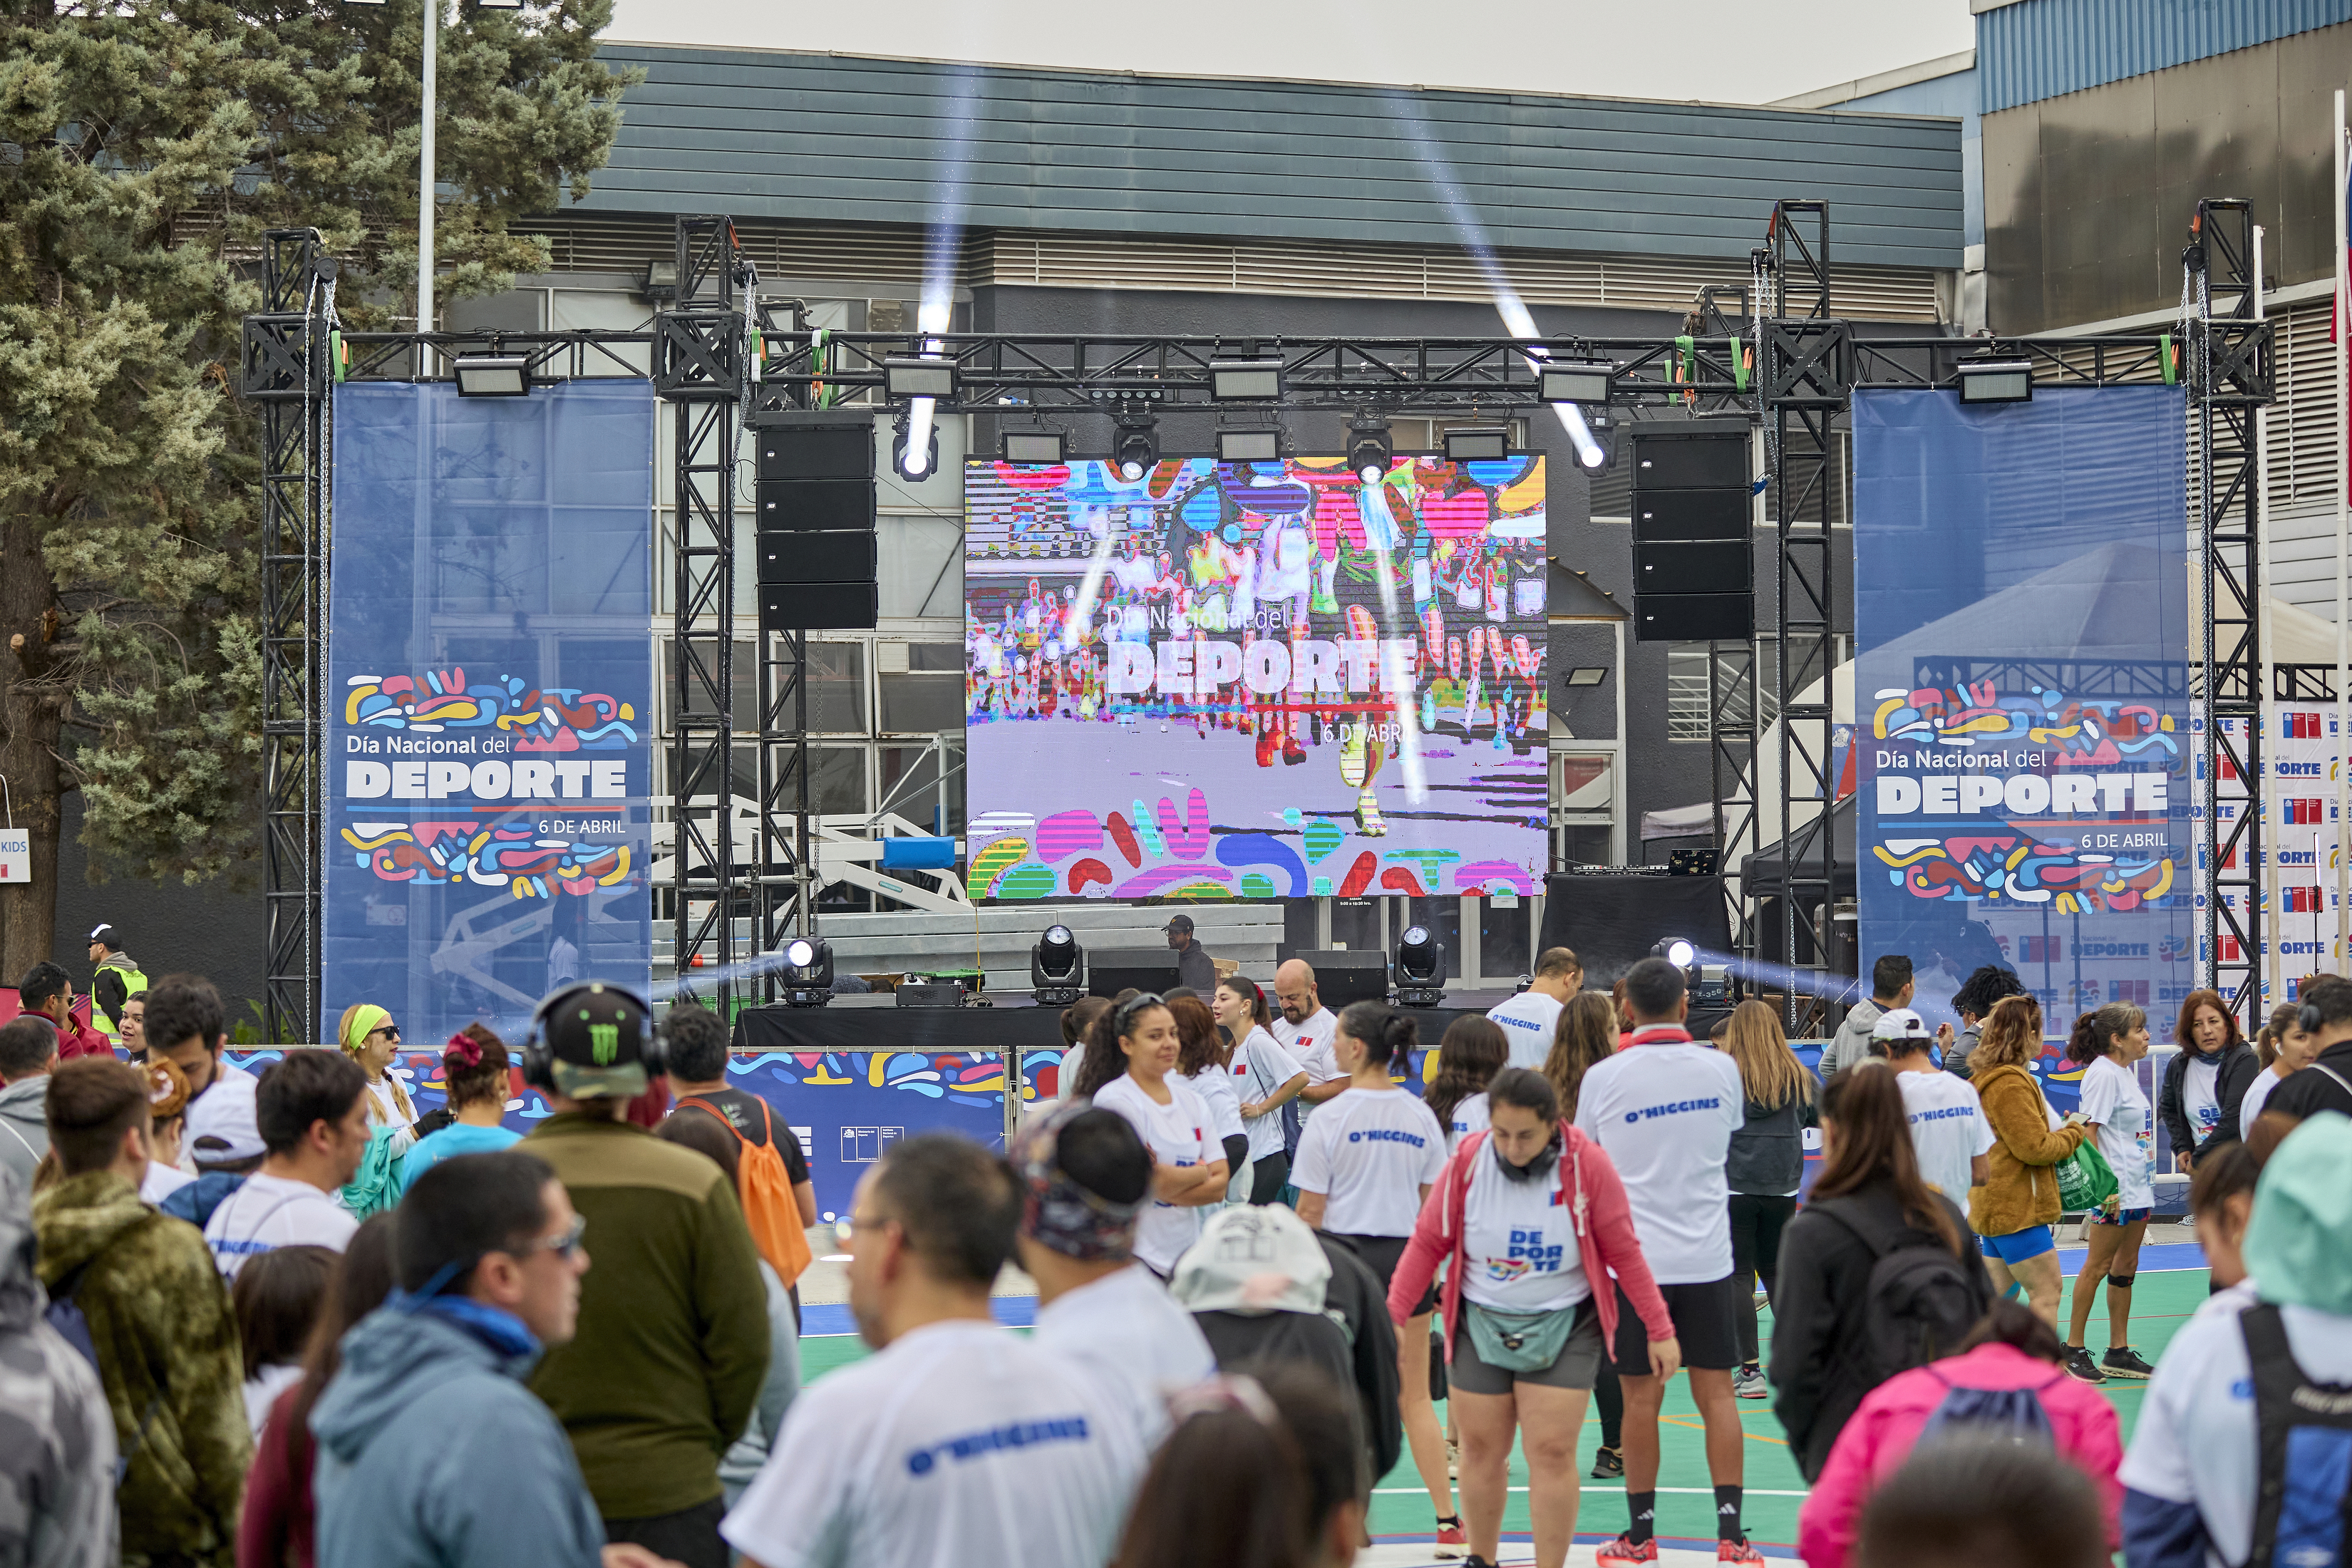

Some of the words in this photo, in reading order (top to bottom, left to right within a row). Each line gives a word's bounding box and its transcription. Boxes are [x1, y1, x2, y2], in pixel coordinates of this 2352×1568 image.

[1255, 604, 1291, 629] del
[1108, 639, 1417, 693] DEPORTE
[1324, 723, 1334, 743] 6
[346, 736, 381, 754] Día
[387, 736, 477, 754] Nacional
[482, 736, 510, 754] del
[1876, 750, 1909, 769] Día
[1915, 749, 2010, 769] Nacional
[2015, 749, 2047, 768] del
[346, 760, 626, 799] DEPORTE
[1877, 772, 2168, 815] DEPORTE
[538, 820, 549, 834] 6
[553, 820, 576, 834] DE
[579, 820, 626, 834] ABRIL
[1, 841, 27, 852] KIDS
[2081, 834, 2092, 849] 6
[2096, 833, 2119, 848] DE
[2123, 832, 2168, 848] ABRIL
[2070, 943, 2149, 956] DEPORTE
[1492, 1014, 1541, 1031] O'HIGGINS
[1624, 1098, 1719, 1123] O'HIGGINS
[1907, 1106, 1974, 1125] O'HIGGINS
[1348, 1130, 1425, 1148] O'HIGGINS
[1510, 1230, 1542, 1244] DE
[1508, 1245, 1563, 1259] POR
